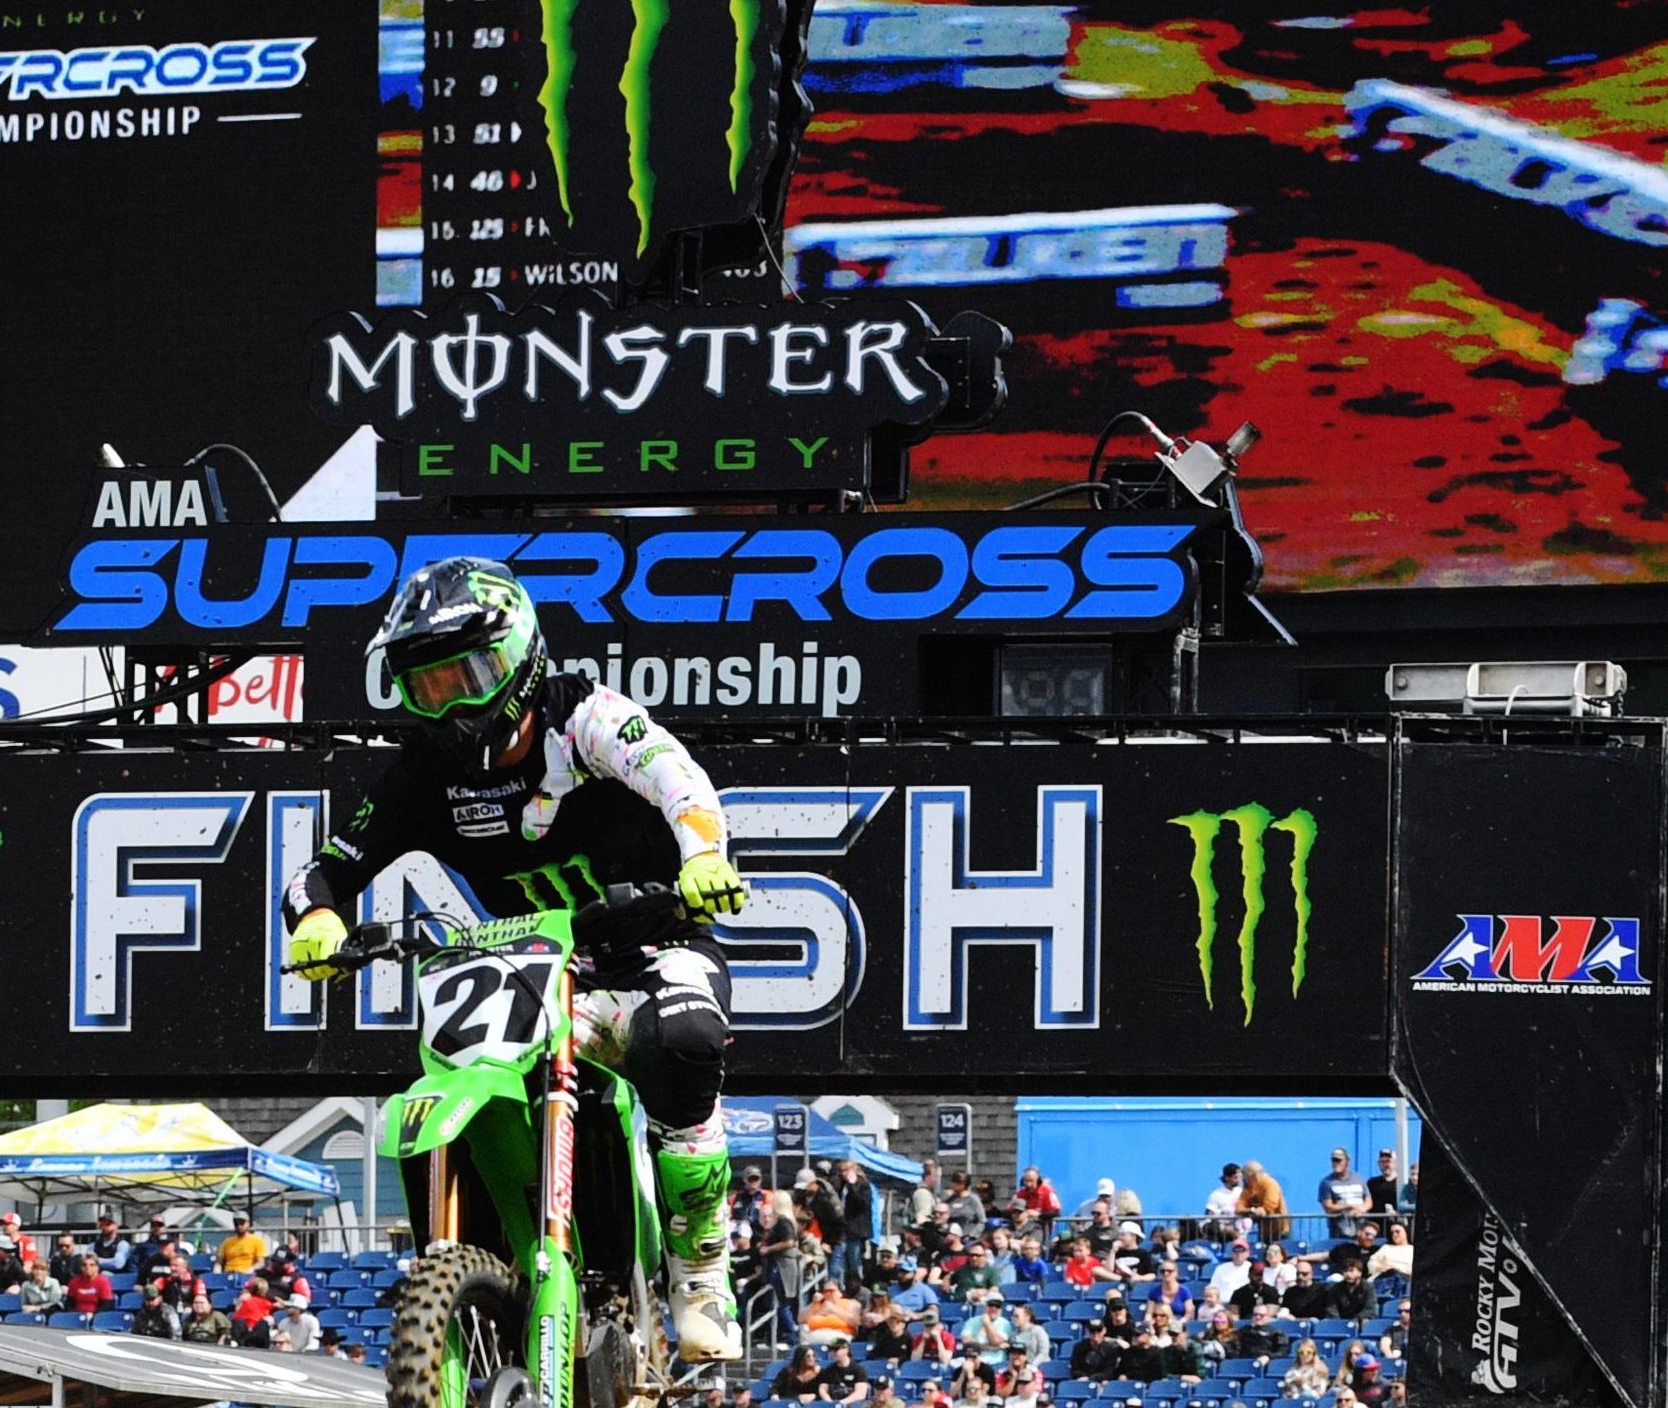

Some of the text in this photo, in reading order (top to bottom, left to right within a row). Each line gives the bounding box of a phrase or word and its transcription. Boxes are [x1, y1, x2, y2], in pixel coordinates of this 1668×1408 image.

[432, 125, 456, 143] 13
[432, 174, 455, 191] 14
[432, 269, 456, 288] 16
[525, 262, 618, 285] WILSON
[327, 310, 927, 420] MONSTER
[419, 437, 829, 477] ENERGY
[91, 480, 208, 528] AMA
[365, 641, 862, 718] Cpionship
[70, 785, 1104, 1032] FINSH
[1410, 914, 1653, 985] AMA
[430, 962, 557, 1058] 21
[1412, 982, 1651, 997] AMERICAN MOTORCYCLIST ASSOCIATION
[778, 1113, 802, 1129] 123
[939, 1113, 964, 1128] 124
[1472, 1274, 1494, 1354] ROCKY
